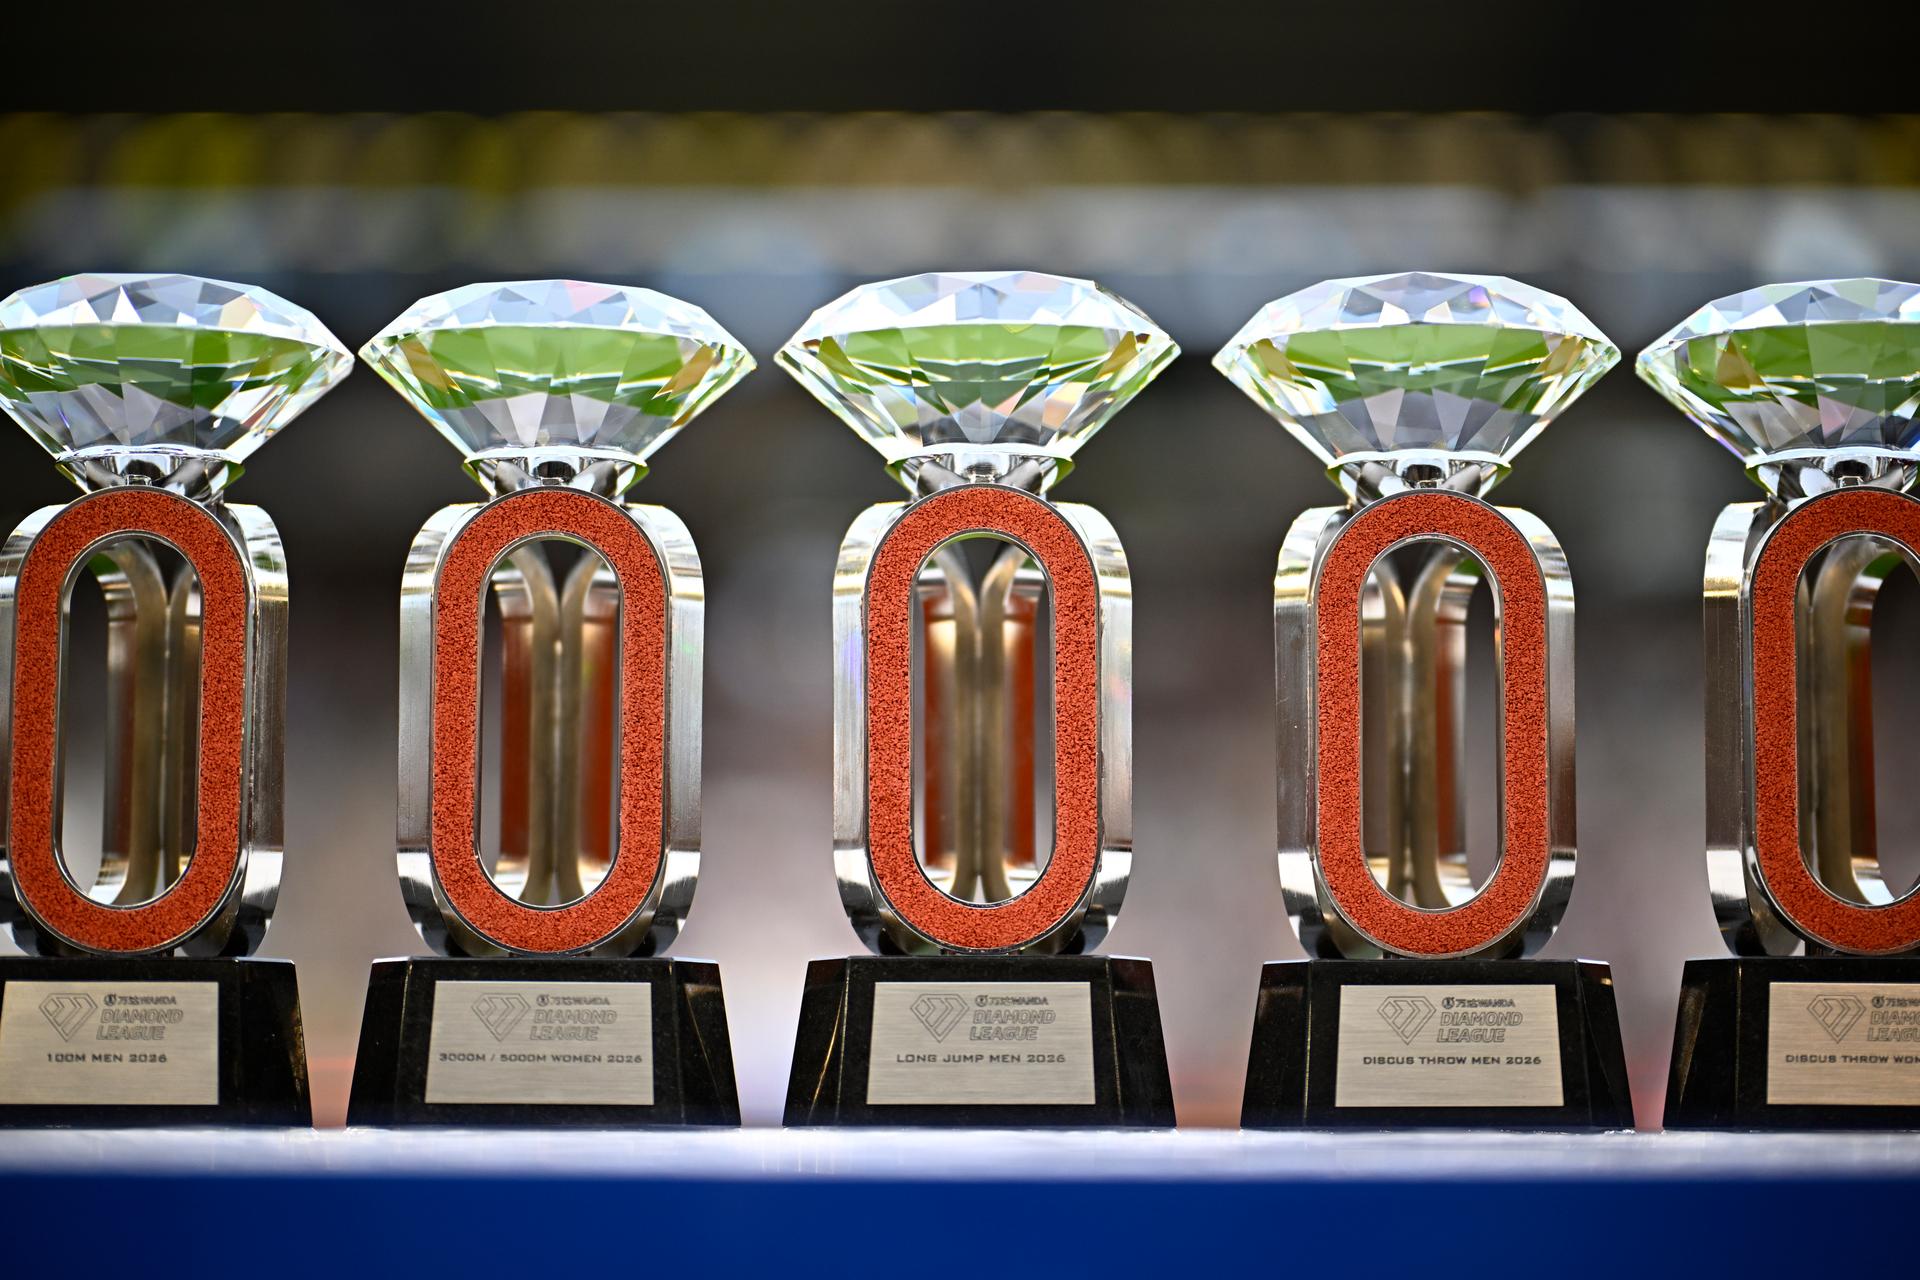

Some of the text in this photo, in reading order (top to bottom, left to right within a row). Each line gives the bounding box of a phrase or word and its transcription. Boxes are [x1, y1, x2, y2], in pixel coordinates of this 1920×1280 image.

[100, 1008, 184, 1024] DIAMOND
[533, 1009, 617, 1024] DIAMOND
[972, 1009, 1056, 1025] DIAMOND
[1440, 1011, 1524, 1027] DIAMOND
[96, 1025, 166, 1040] LEAGUE
[529, 1026, 600, 1041] LEAGUE
[969, 1026, 1040, 1041] LEAGUE
[1436, 1028, 1507, 1043] LEAGUE
[47, 1053, 167, 1063] 100M MEN 2026
[439, 1052, 486, 1062] 3000M
[500, 1053, 547, 1063] 5000M
[551, 1053, 602, 1063] WOMEN
[607, 1054, 643, 1063] 2026
[896, 1054, 1066, 1063] LONG JUMP MEN 2026
[1363, 1056, 1542, 1065] DISCUS THROW MEN 2026
[1785, 1054, 1838, 1064] DISCUS
[1840, 1054, 1889, 1064] THROW
